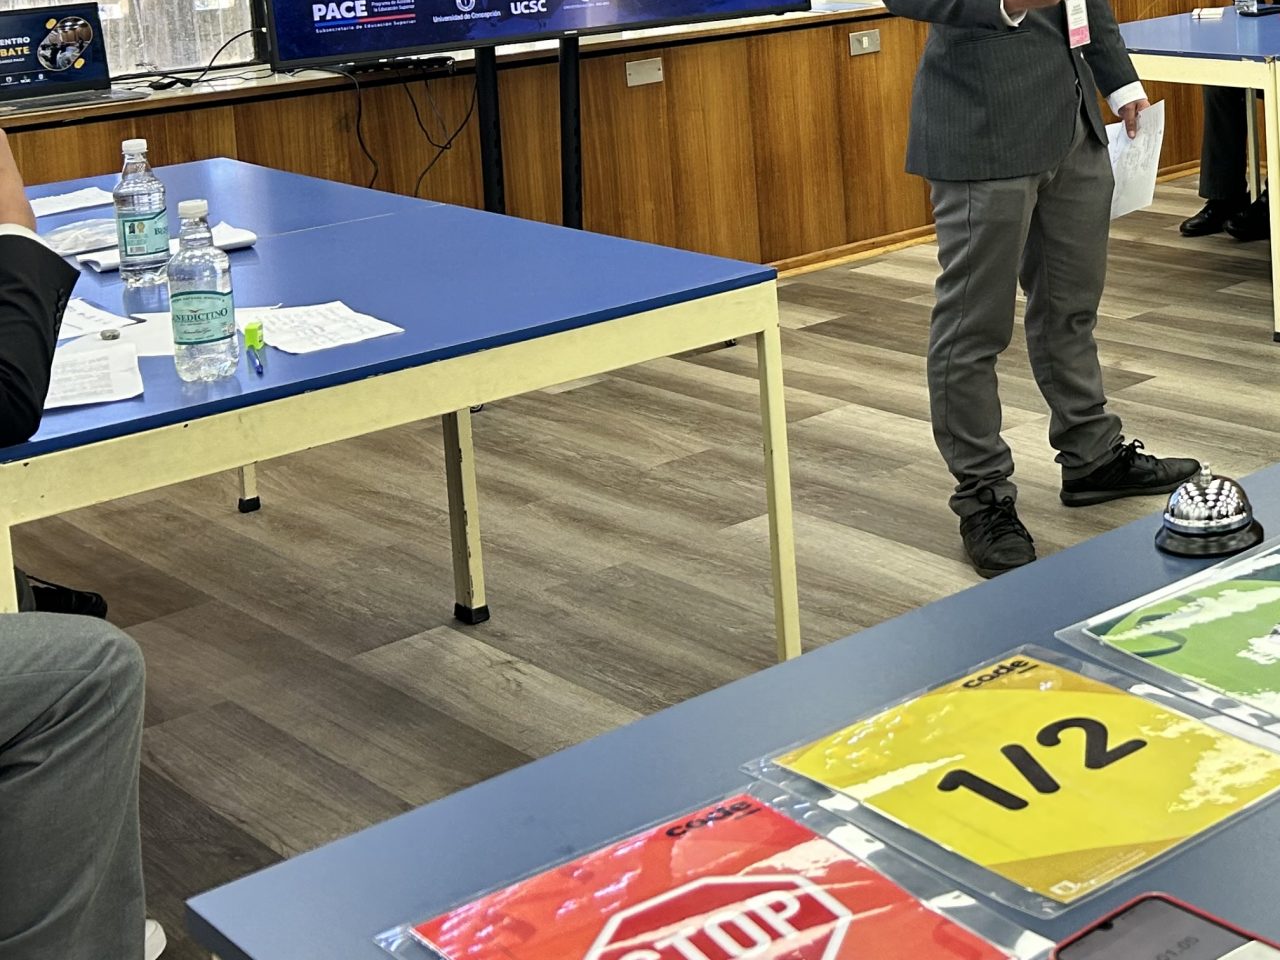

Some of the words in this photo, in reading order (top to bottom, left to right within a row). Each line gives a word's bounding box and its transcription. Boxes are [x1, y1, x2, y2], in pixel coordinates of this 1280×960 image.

[312, 0, 368, 21] PACE
[510, 0, 547, 15] UCSC
[172, 307, 229, 323] NEDICTINO
[936, 716, 1148, 811] 1/2
[616, 890, 801, 960] TOP
